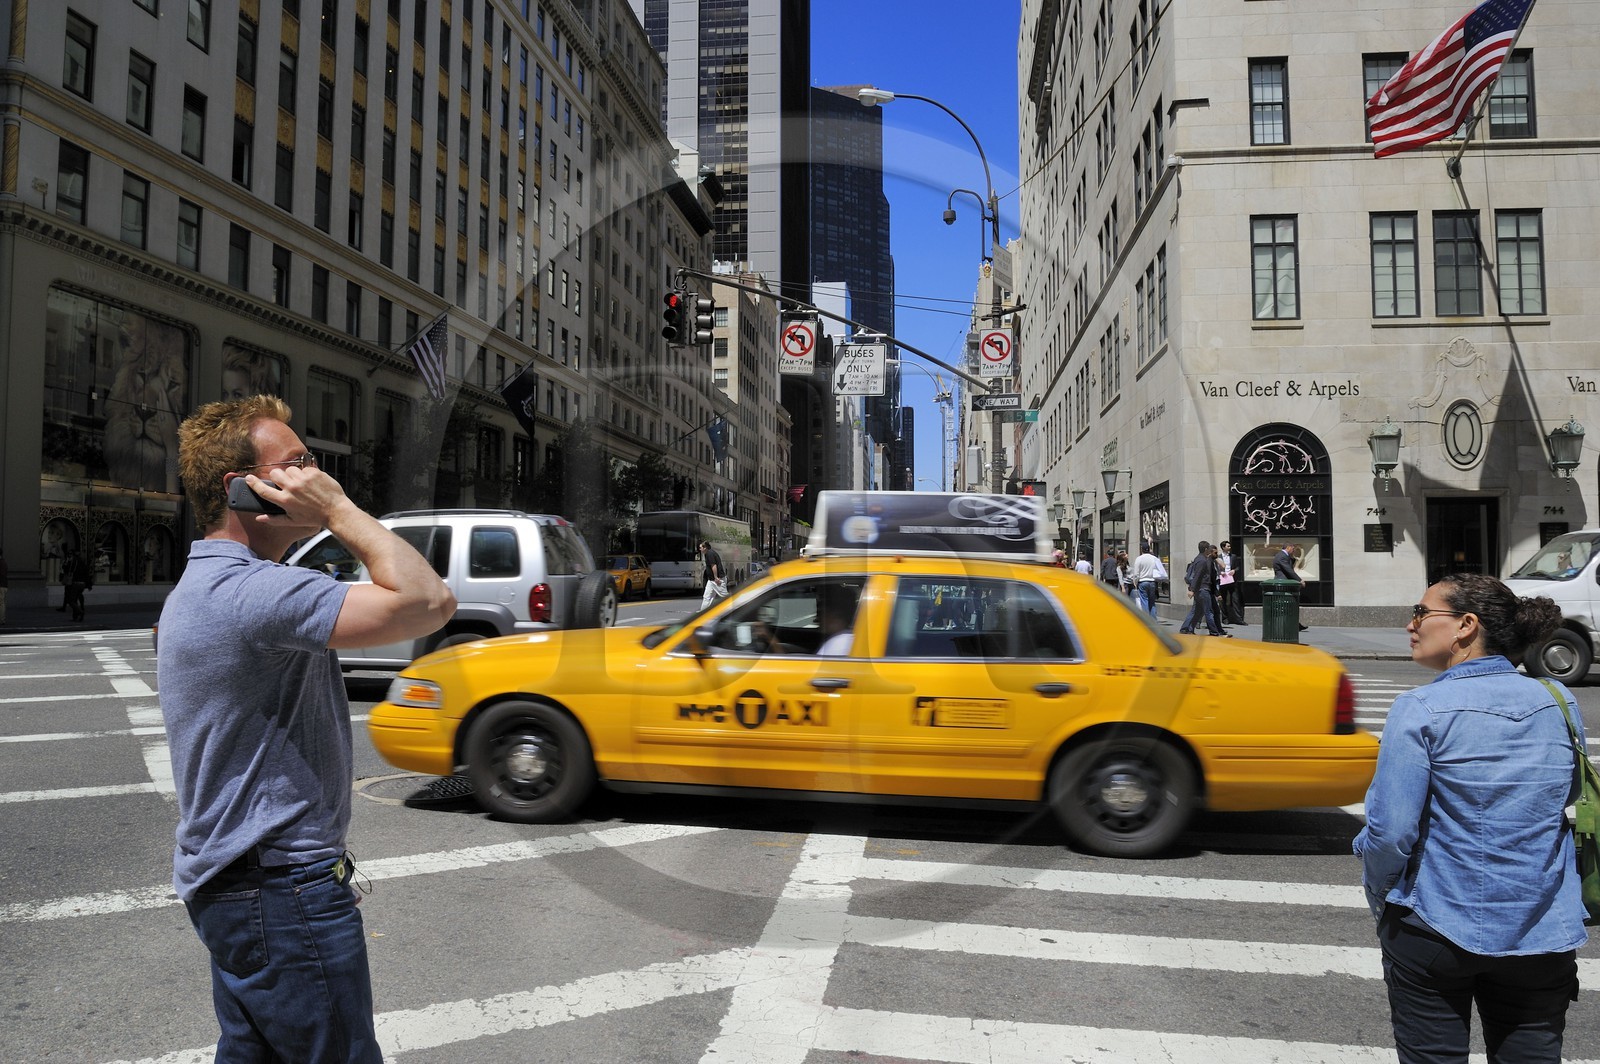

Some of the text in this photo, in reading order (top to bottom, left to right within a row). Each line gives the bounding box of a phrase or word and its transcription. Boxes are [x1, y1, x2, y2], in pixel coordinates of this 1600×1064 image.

[844, 349, 874, 358] BUSES
[846, 364, 872, 373] ONLY
[1566, 376, 1597, 393] Van
[1200, 380, 1360, 400] Van Cleef & Arpels
[1256, 480, 1280, 489] Cleef
[1284, 480, 1293, 489] &
[1296, 480, 1324, 491] Arpels
[1366, 508, 1387, 516] 744
[1544, 506, 1565, 515] 744
